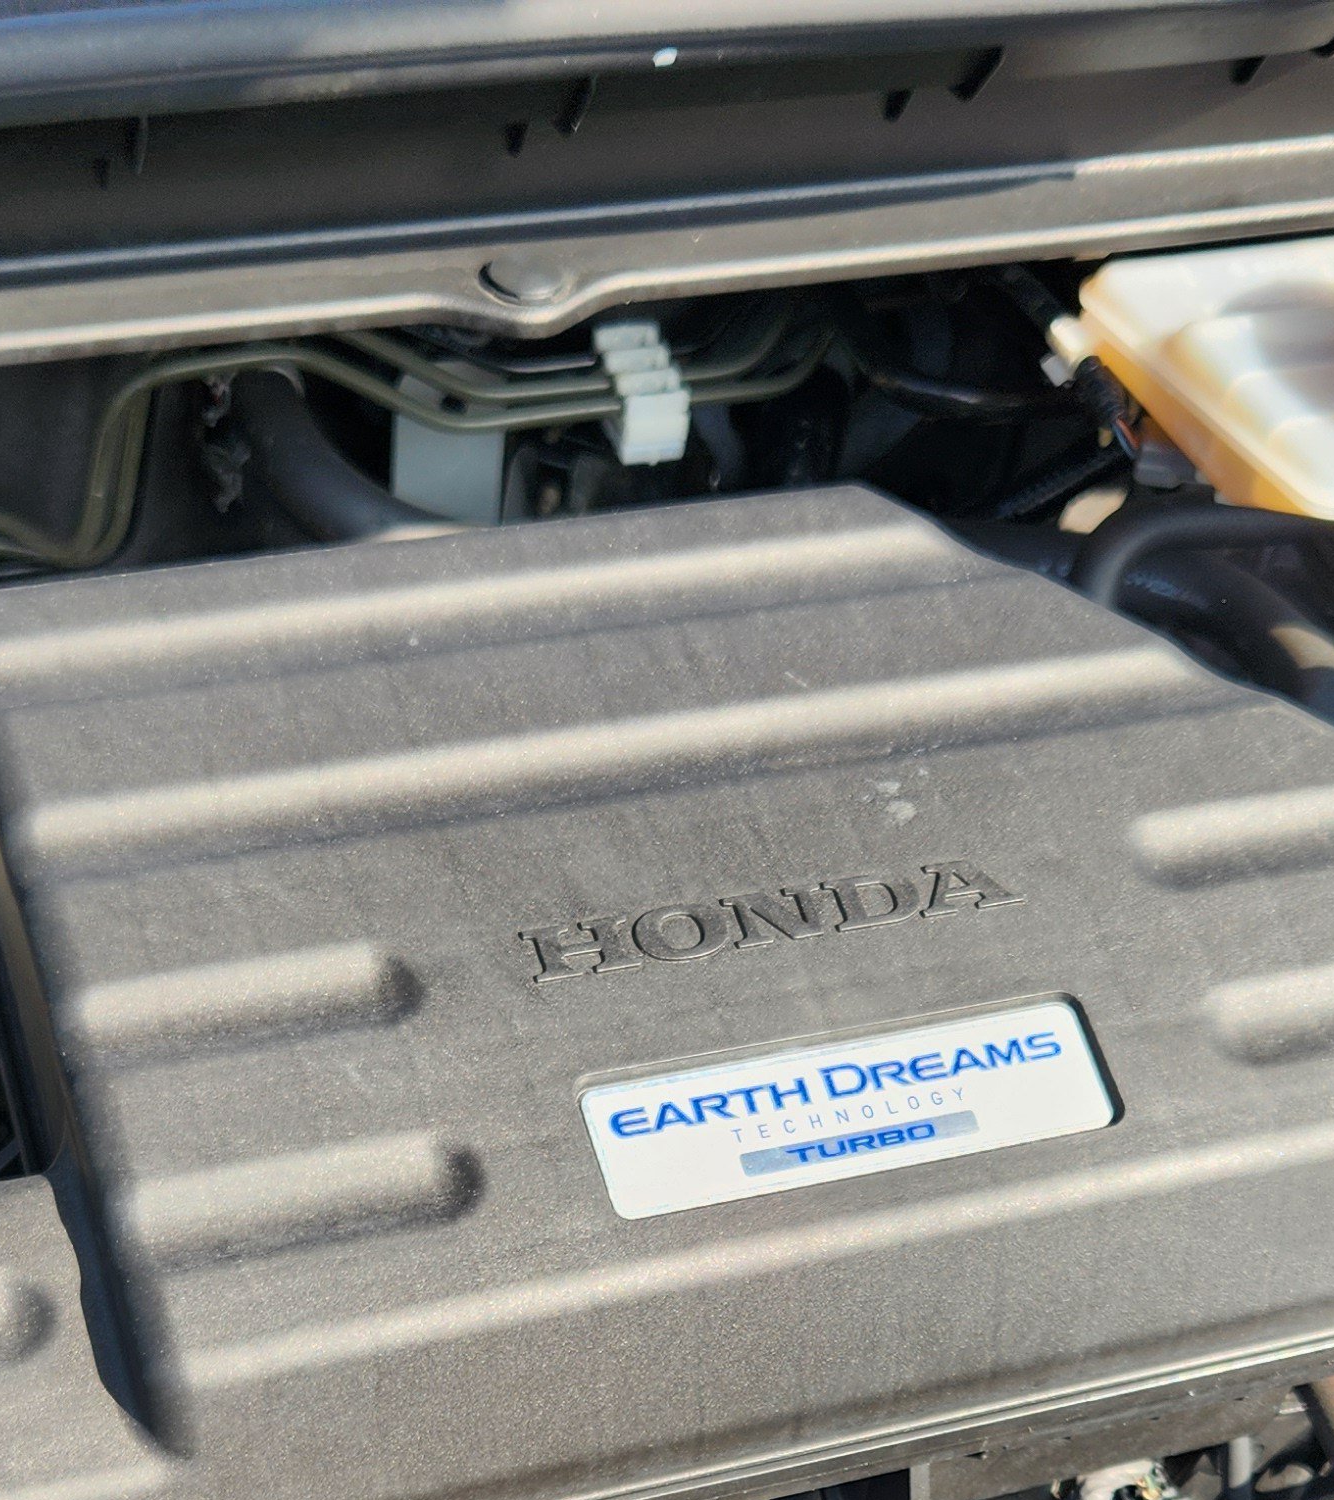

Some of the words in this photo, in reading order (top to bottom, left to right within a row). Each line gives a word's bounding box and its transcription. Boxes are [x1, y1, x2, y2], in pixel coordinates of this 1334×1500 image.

[518, 859, 1026, 984] HONDA
[608, 1077, 814, 1140] EARTH
[817, 1030, 1063, 1099] DREAMS
[730, 1087, 968, 1145] TECHNOLOGY
[785, 1122, 937, 1165] TURBO
